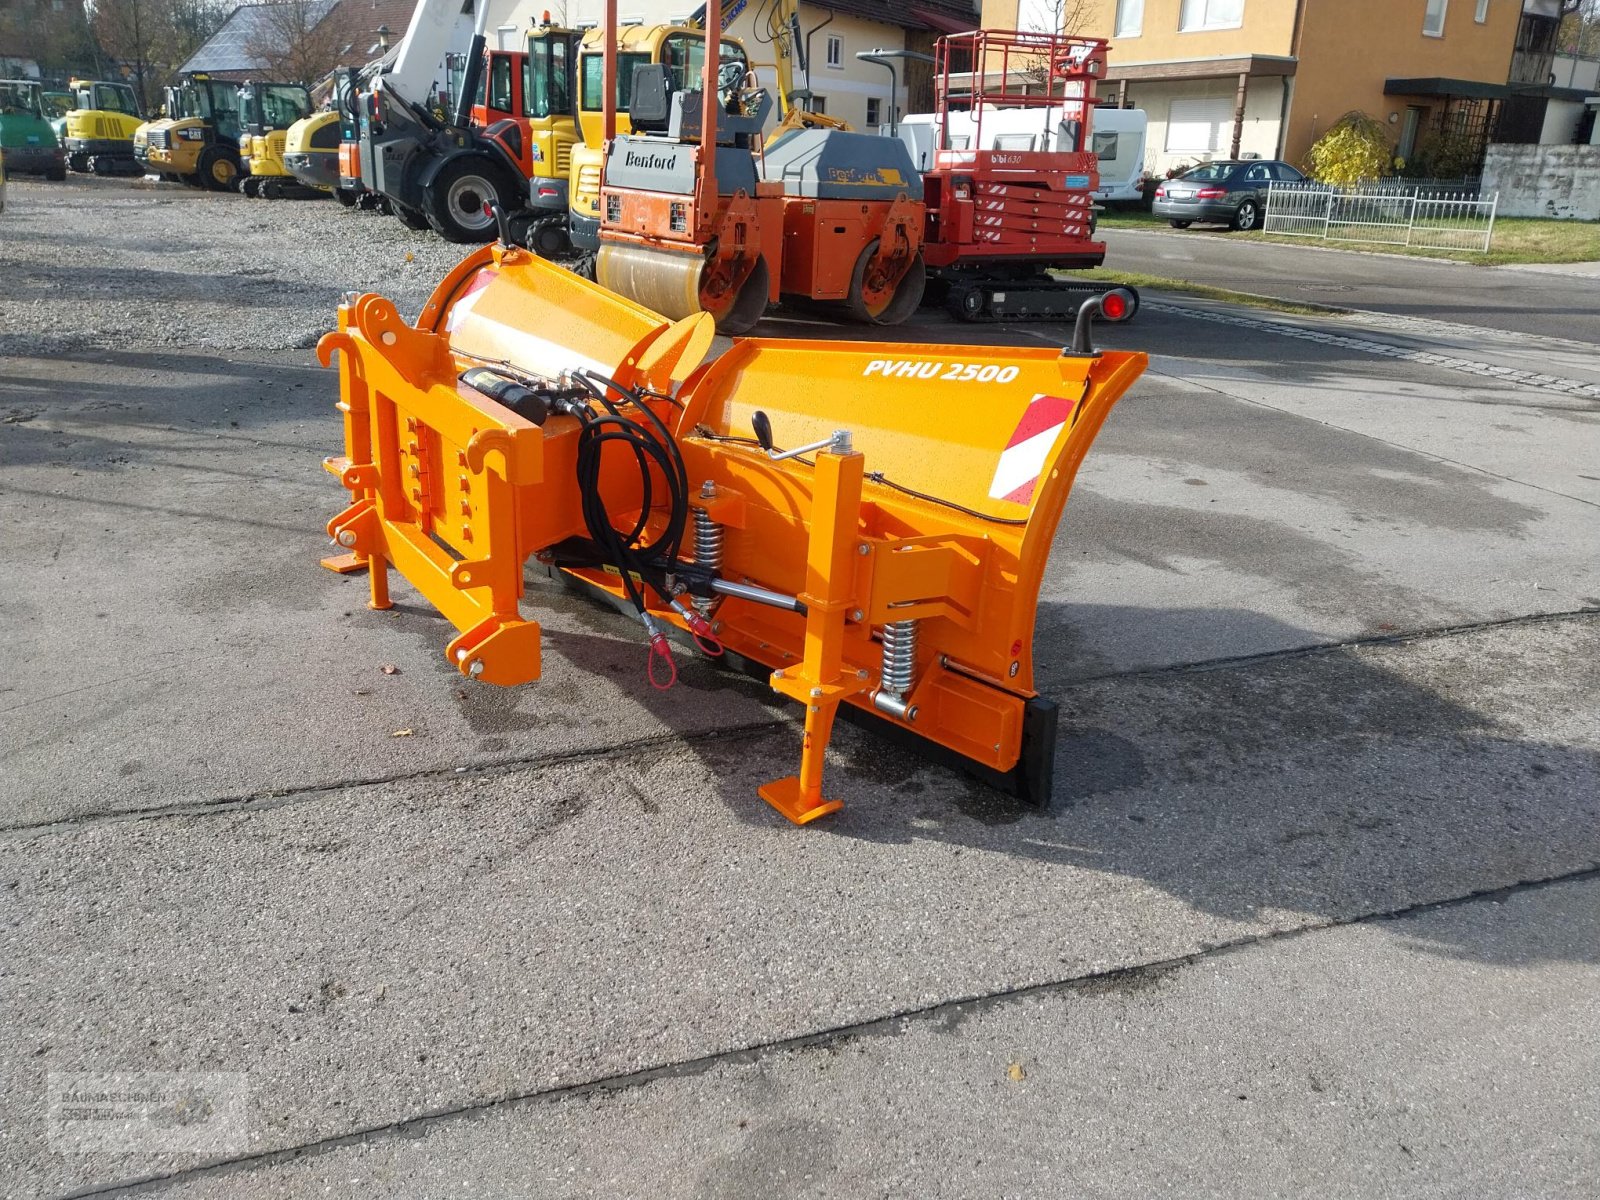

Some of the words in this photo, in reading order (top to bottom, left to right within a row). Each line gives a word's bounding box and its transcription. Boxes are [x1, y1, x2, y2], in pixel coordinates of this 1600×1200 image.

[626, 151, 676, 170] Benford
[862, 360, 943, 379] PVHU
[940, 363, 1020, 383] 2500
